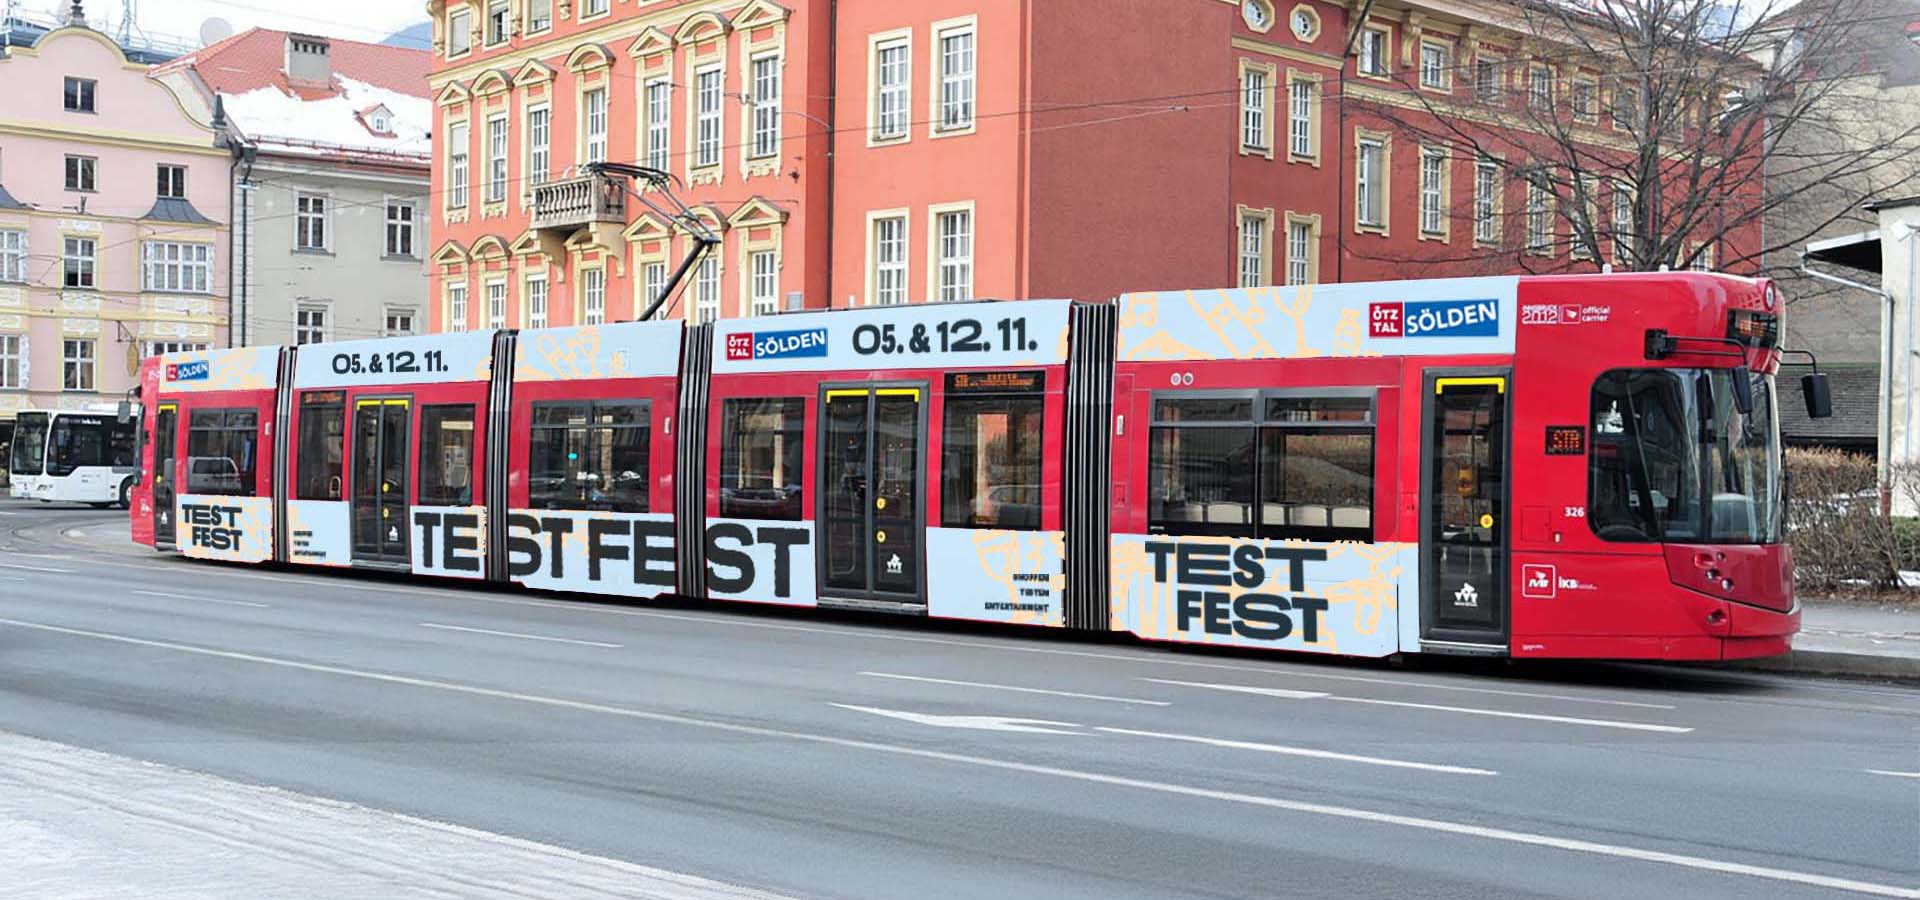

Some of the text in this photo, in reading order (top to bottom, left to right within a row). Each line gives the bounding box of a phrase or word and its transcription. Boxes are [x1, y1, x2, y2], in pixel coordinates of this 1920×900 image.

[1373, 306, 1398, 320] ÖTZ
[1406, 302, 1497, 333] SÖLDEN
[1522, 310, 1558, 324] 2012
[852, 317, 1038, 355] 05. & 12. 11.
[1373, 322, 1398, 333] TAL
[728, 348, 749, 357] TAL
[756, 331, 825, 357] SÖLDEN
[332, 350, 448, 374] 05. & 12. 11.
[182, 504, 242, 527] TEST
[1564, 507, 1584, 517] 326
[192, 526, 242, 551] FEST
[1145, 541, 1327, 592] TEST
[1177, 590, 1329, 643] FEST
